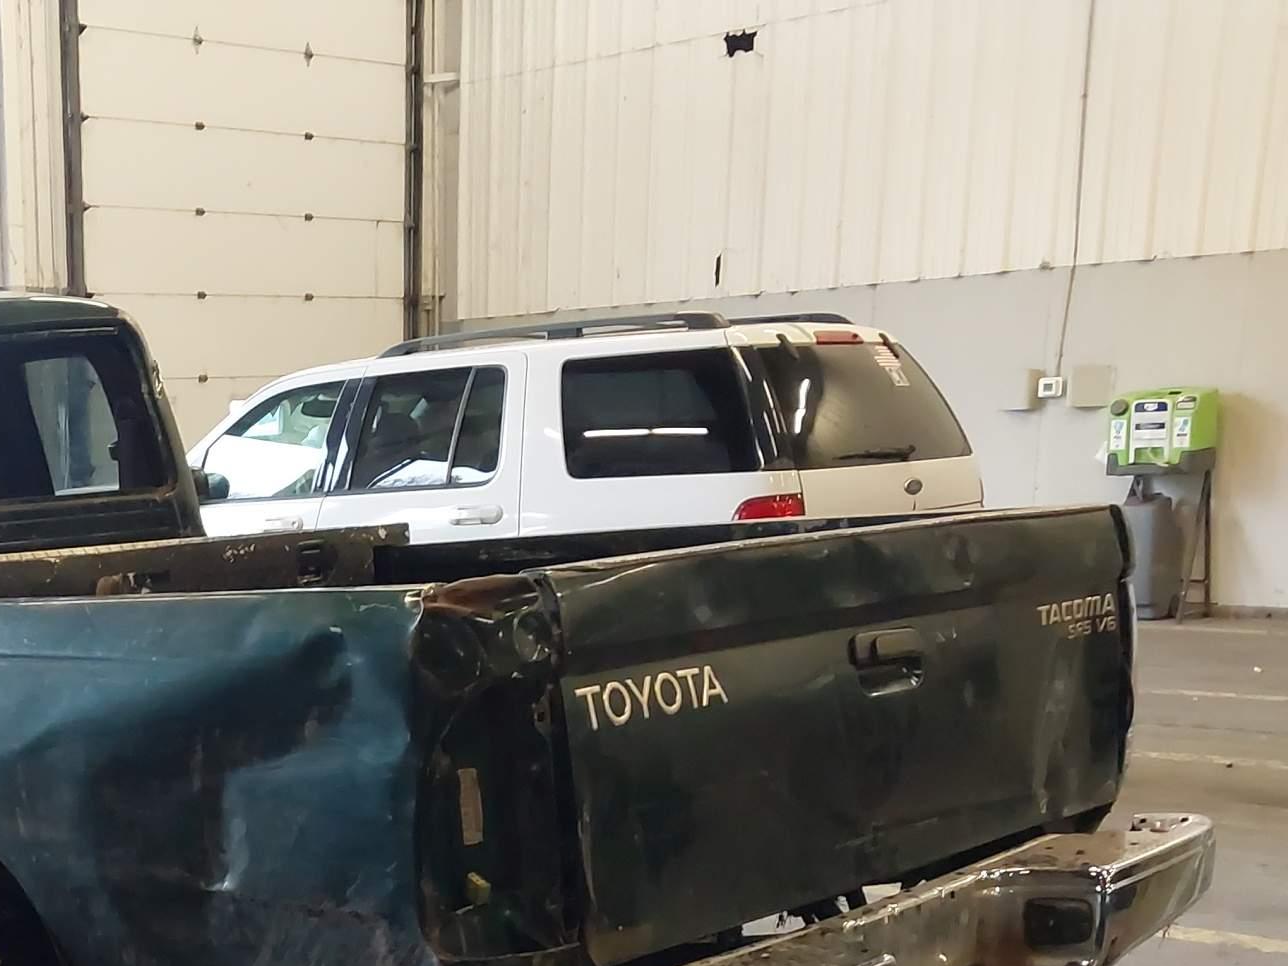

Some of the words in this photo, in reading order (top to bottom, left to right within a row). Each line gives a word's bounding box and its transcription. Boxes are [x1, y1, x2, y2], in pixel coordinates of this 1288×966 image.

[1036, 592, 1116, 626] TACOMA
[1096, 616, 1116, 633] V6
[574, 664, 729, 731] TOYOTA
